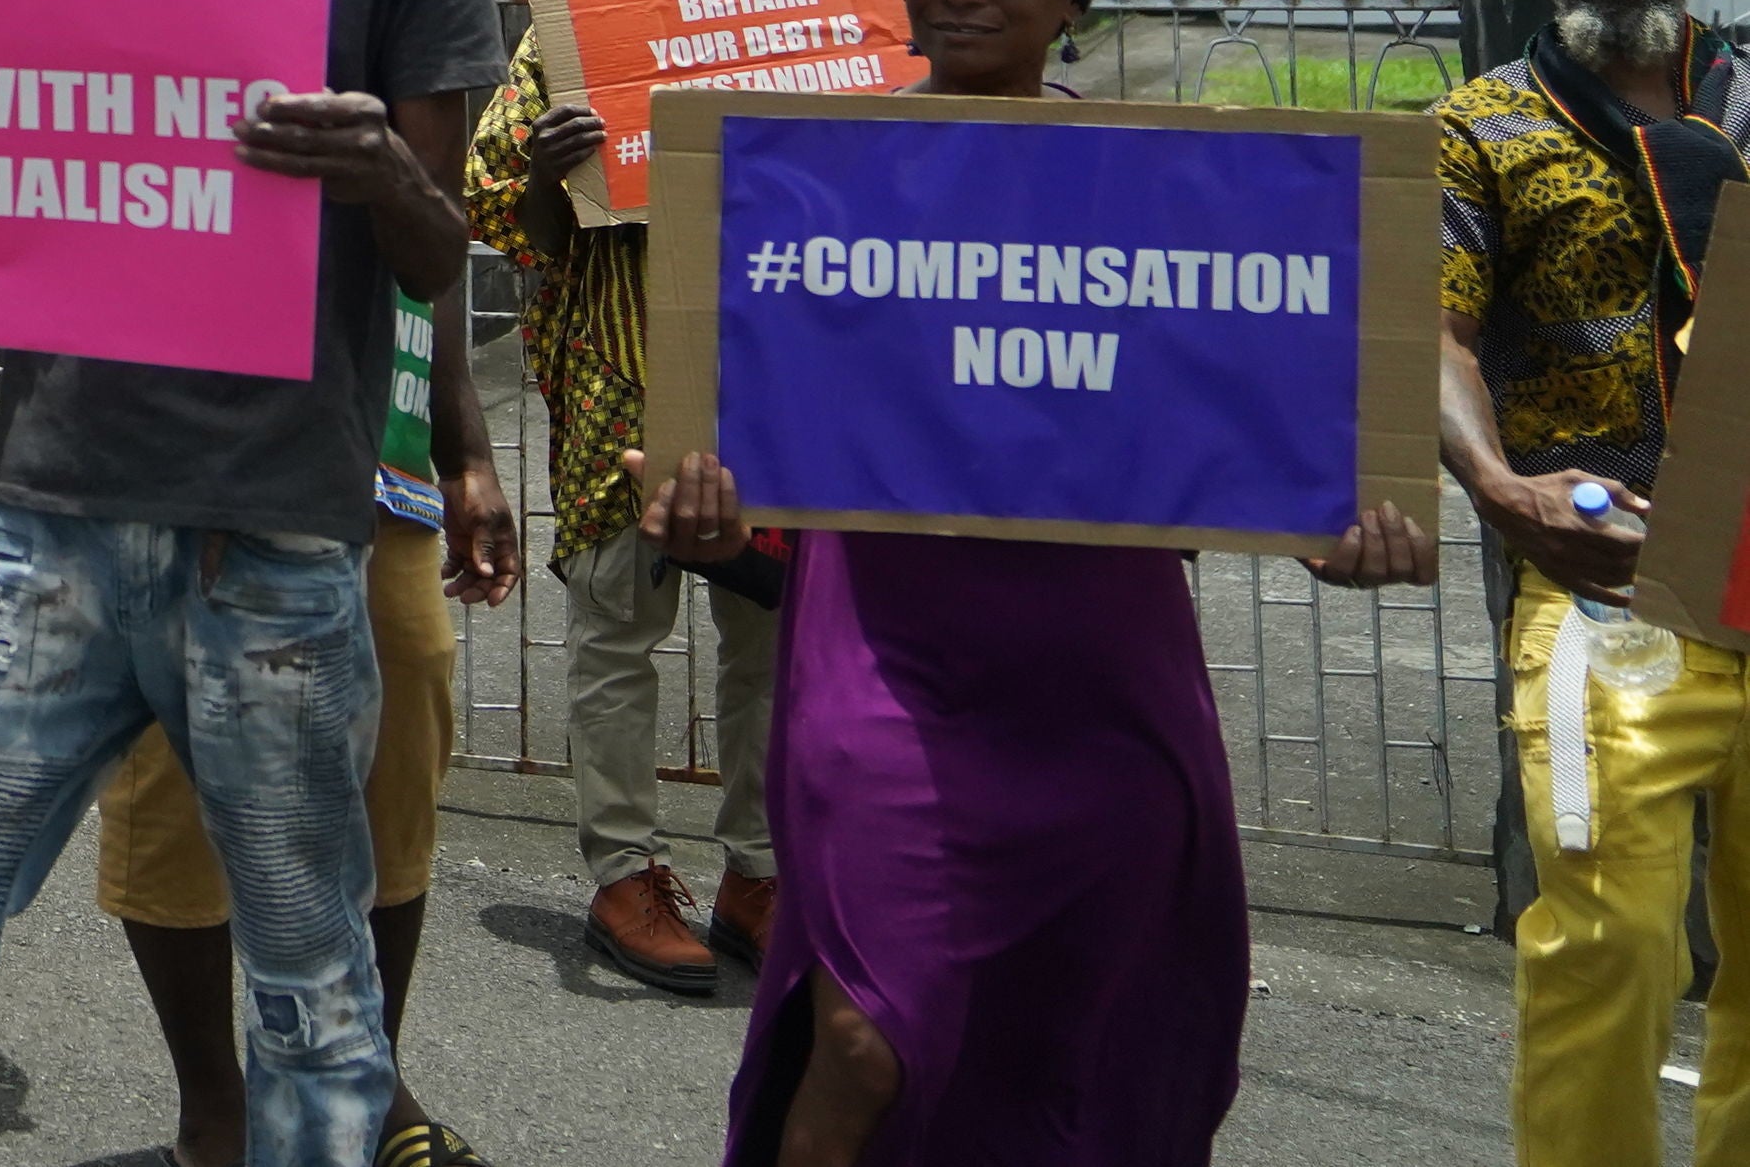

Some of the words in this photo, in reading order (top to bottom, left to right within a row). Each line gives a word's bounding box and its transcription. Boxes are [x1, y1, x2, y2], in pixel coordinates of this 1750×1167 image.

[648, 30, 739, 71] YOUR
[743, 18, 825, 57] DEBT
[829, 13, 865, 46] IS
[748, 236, 1331, 315] #COMPENSATION
[954, 326, 1120, 391] NOW
